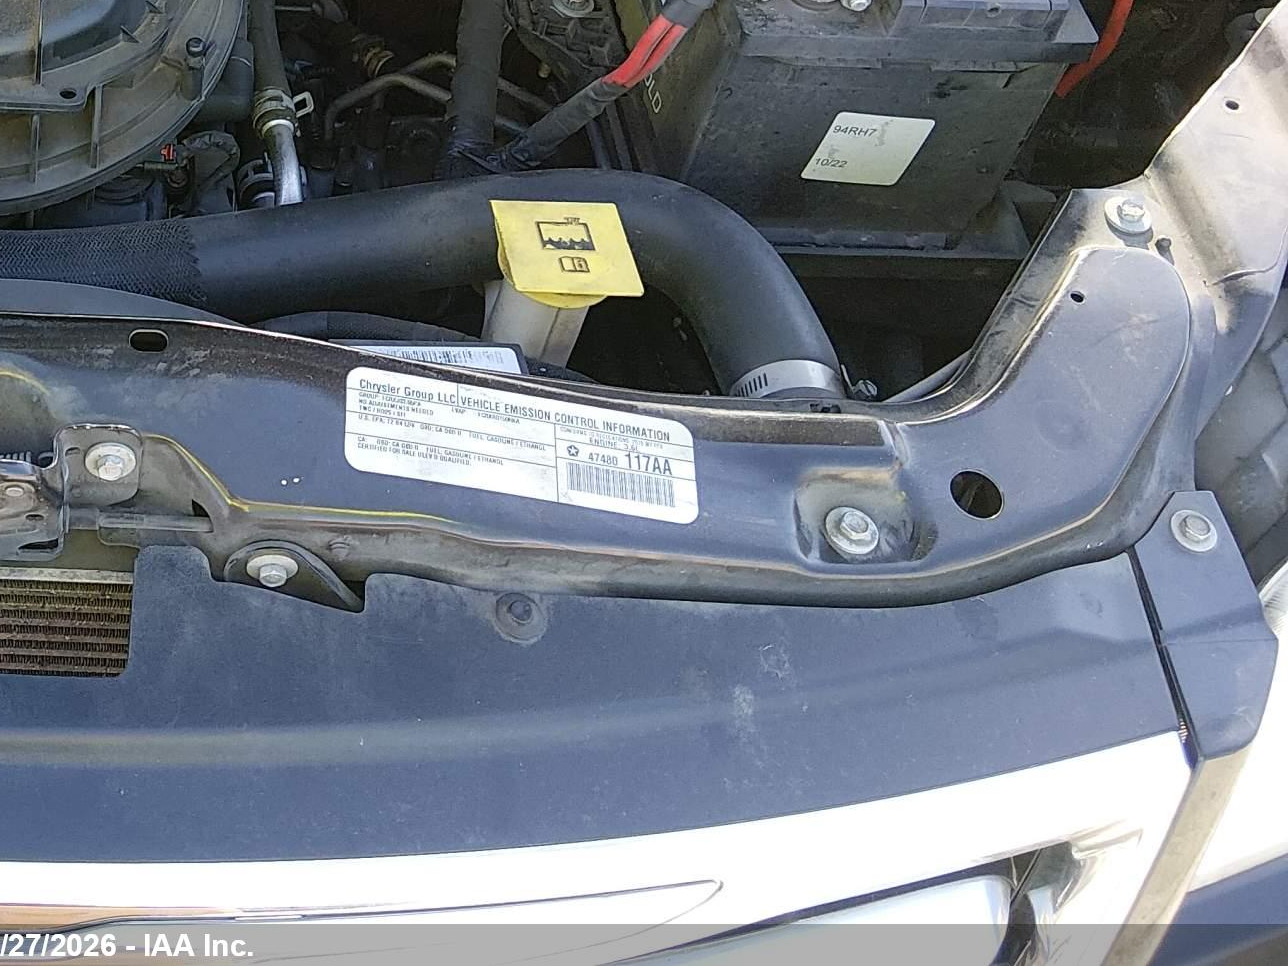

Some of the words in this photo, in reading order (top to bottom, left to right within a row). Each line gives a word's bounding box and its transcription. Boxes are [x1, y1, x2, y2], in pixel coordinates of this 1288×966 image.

[832, 124, 878, 138] 94RH7
[814, 157, 848, 169] 10/22
[359, 378, 401, 394] Chrysler
[404, 386, 434, 401] Group
[437, 392, 456, 404] LLC
[461, 396, 501, 412] VEHICLE
[505, 403, 551, 421] EMISSION
[554, 412, 599, 429] CONTROL
[602, 420, 670, 442] INFORMATION
[588, 452, 618, 466] 47480
[625, 451, 672, 475] 117AA
